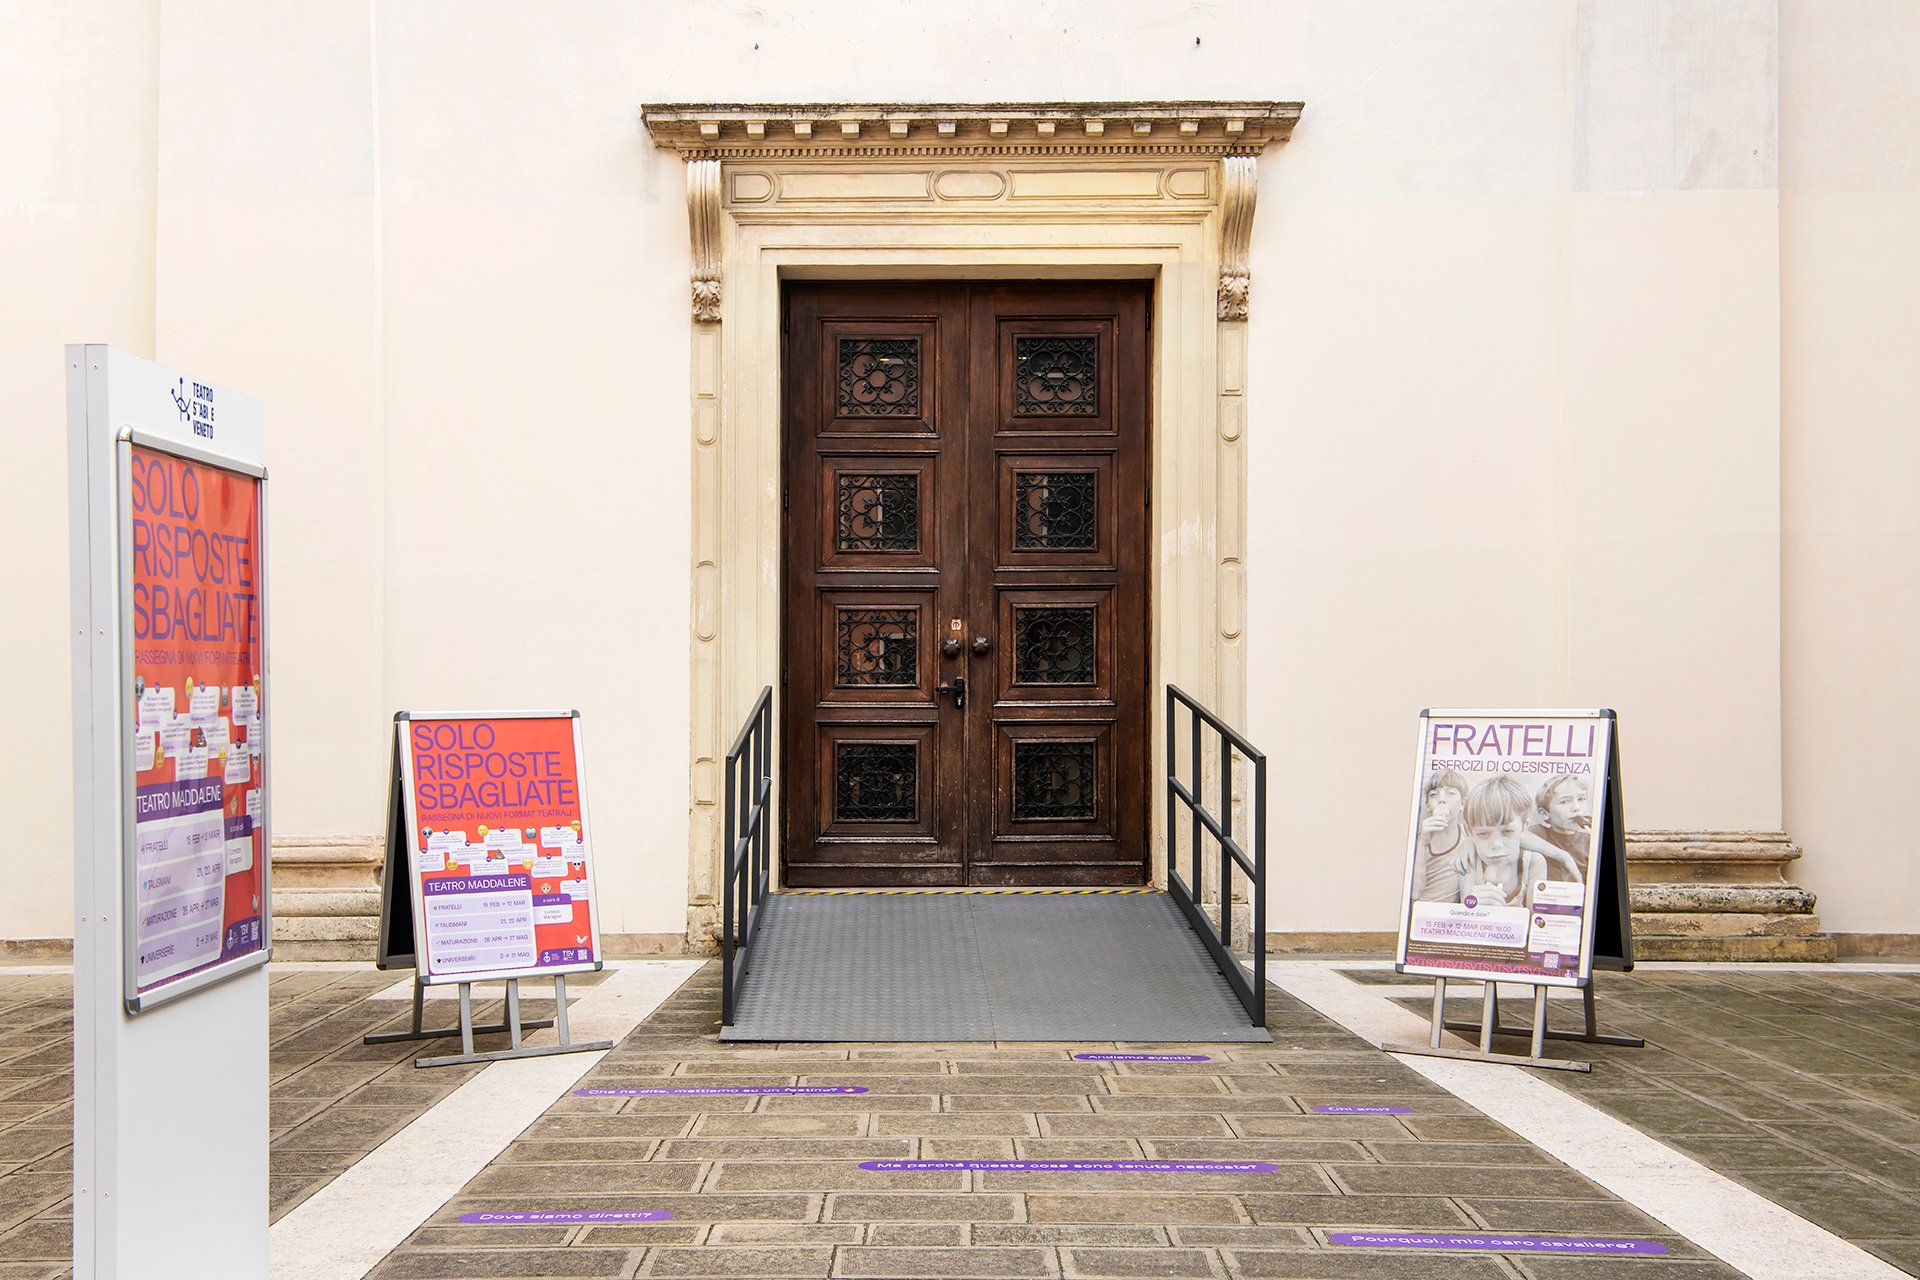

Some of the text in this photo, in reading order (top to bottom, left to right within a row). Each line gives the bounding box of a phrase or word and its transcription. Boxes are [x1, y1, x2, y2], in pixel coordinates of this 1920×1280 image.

[193, 382, 214, 403] TEATRO
[193, 401, 214, 421] SABIE
[193, 420, 214, 439] VENETO
[132, 454, 199, 521] SOLO
[134, 519, 250, 587] RISPOSTE
[134, 582, 256, 643] SBAGLIATE
[414, 723, 495, 751] SOLO
[1432, 724, 1595, 757] FRATELLI
[416, 751, 562, 781] RISPOSTE
[1432, 759, 1591, 774] ESERCIZI DI COESISTENZA
[137, 785, 222, 814] TEATRO MADDALENE
[418, 779, 575, 811] SBAGLIATE
[421, 808, 572, 822] RASSEGNA DI NUOVI FORMAT TEATRALI
[428, 877, 527, 892] TEATRO MADDALENE
[1446, 930, 1487, 938] MADDALENE
[1351, 1235, 1444, 1244] Pourquoi,
[1540, 1241, 1636, 1249] cavaliere?
